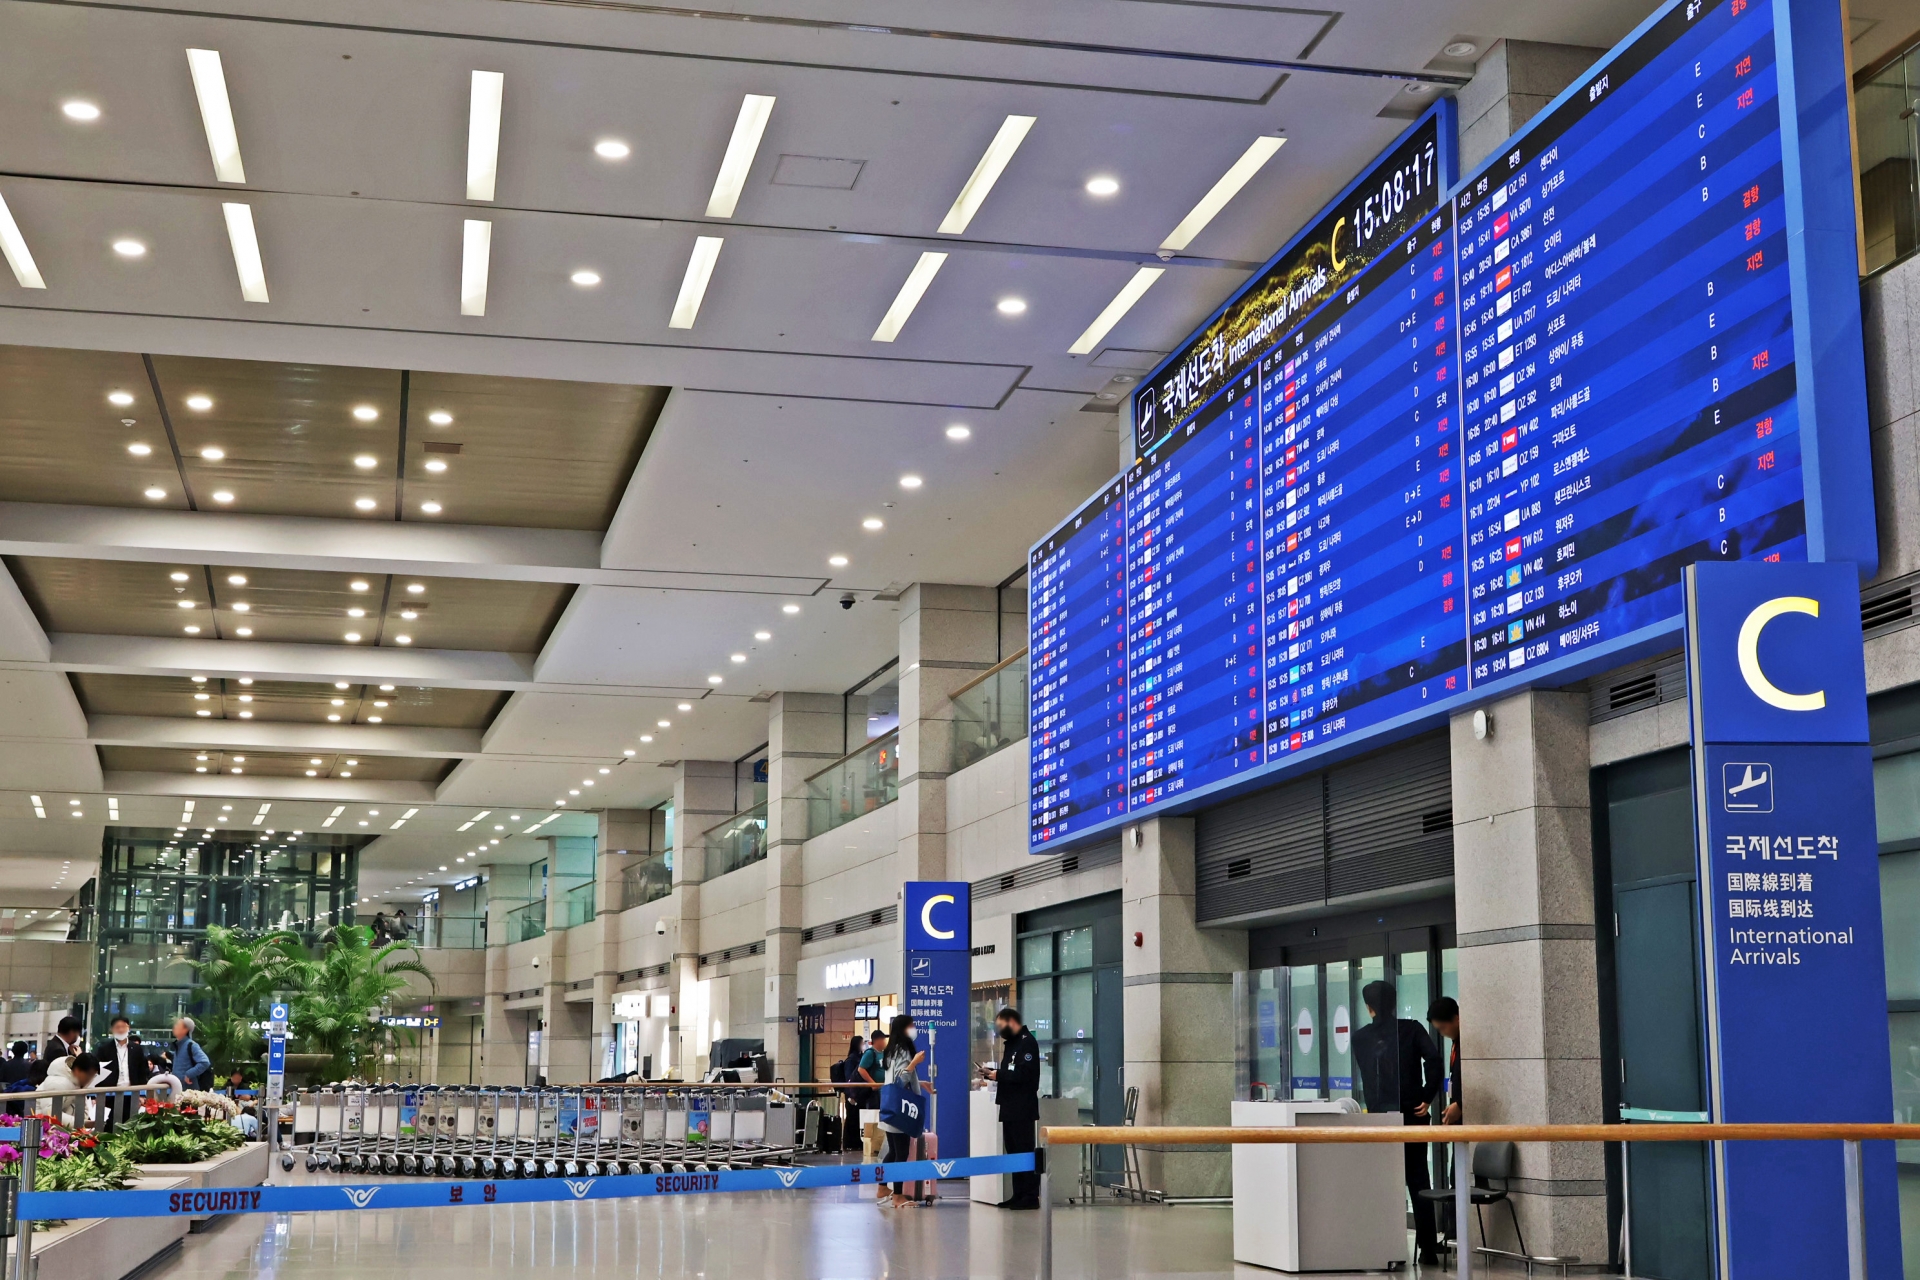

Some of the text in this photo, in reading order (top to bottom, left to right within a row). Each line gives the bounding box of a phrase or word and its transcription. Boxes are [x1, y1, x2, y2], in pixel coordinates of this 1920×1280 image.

[1460, 0, 1702, 208] 시간 변경 편명 출발지 출구
[1509, 208, 1519, 222] VA
[1541, 170, 1565, 198] 싱가포르
[1695, 62, 1701, 77] E
[1511, 234, 1520, 249] CA
[1543, 206, 1555, 226] 선전
[1697, 93, 1703, 108] E
[1735, 56, 1751, 77] 지연
[1508, 180, 1518, 196] OZ
[1512, 261, 1520, 276] 7C
[1544, 229, 1562, 253] 오이타
[1699, 124, 1705, 139] C
[1737, 88, 1753, 109] 지연
[1513, 287, 1521, 303] ET
[1700, 156, 1707, 171] B
[1229, 142, 1434, 367] International Arrivals C 15:08:17
[1514, 315, 1523, 330] UA
[1562, 273, 1581, 296] 나리타
[1702, 187, 1709, 202] B
[1515, 342, 1523, 357] ET
[1547, 314, 1566, 337] 삿포로
[1743, 185, 1759, 208] 결항
[1516, 368, 1525, 384] OZ
[1745, 218, 1761, 241] 결항
[1162, 333, 1225, 419] 국제선도착
[1517, 396, 1526, 411] OZ
[1550, 374, 1562, 392] 로마
[1707, 282, 1714, 296] B
[1747, 251, 1763, 270] 지연
[1518, 423, 1528, 438] TW
[1709, 313, 1715, 328] E
[1437, 392, 1447, 408] 도착
[1519, 451, 1528, 466] OZ
[1552, 424, 1577, 448] 구마모토
[1711, 345, 1717, 361] B
[1520, 479, 1529, 493] YP
[1712, 378, 1719, 393] B
[1752, 350, 1768, 370] 지연
[1521, 507, 1531, 521] UA
[1714, 409, 1721, 425] E
[1522, 534, 1532, 548] TW
[1756, 417, 1773, 439] 결항
[1523, 562, 1532, 576] VN
[1717, 474, 1724, 490] C
[1758, 451, 1774, 470] 지연
[1524, 590, 1534, 605] OZ
[1558, 568, 1582, 591] 후쿠오카
[1719, 507, 1726, 523] B
[1525, 618, 1535, 632] VN
[1558, 600, 1577, 619] 하노이
[1721, 540, 1728, 555] C
[1526, 646, 1536, 660] OZ
[1738, 596, 1826, 711] C
[1725, 835, 1839, 861] 국제선도착
[1727, 872, 1813, 892] 国際線到着
[921, 895, 955, 940] C
[1728, 899, 1814, 918] 国际线到达
[1729, 927, 1853, 944] International
[1729, 948, 1801, 965] Arrivals
[910, 985, 954, 995] 국제선도착
[169, 1190, 261, 1213] SECURITY
[655, 1174, 719, 1193] SECURITY
